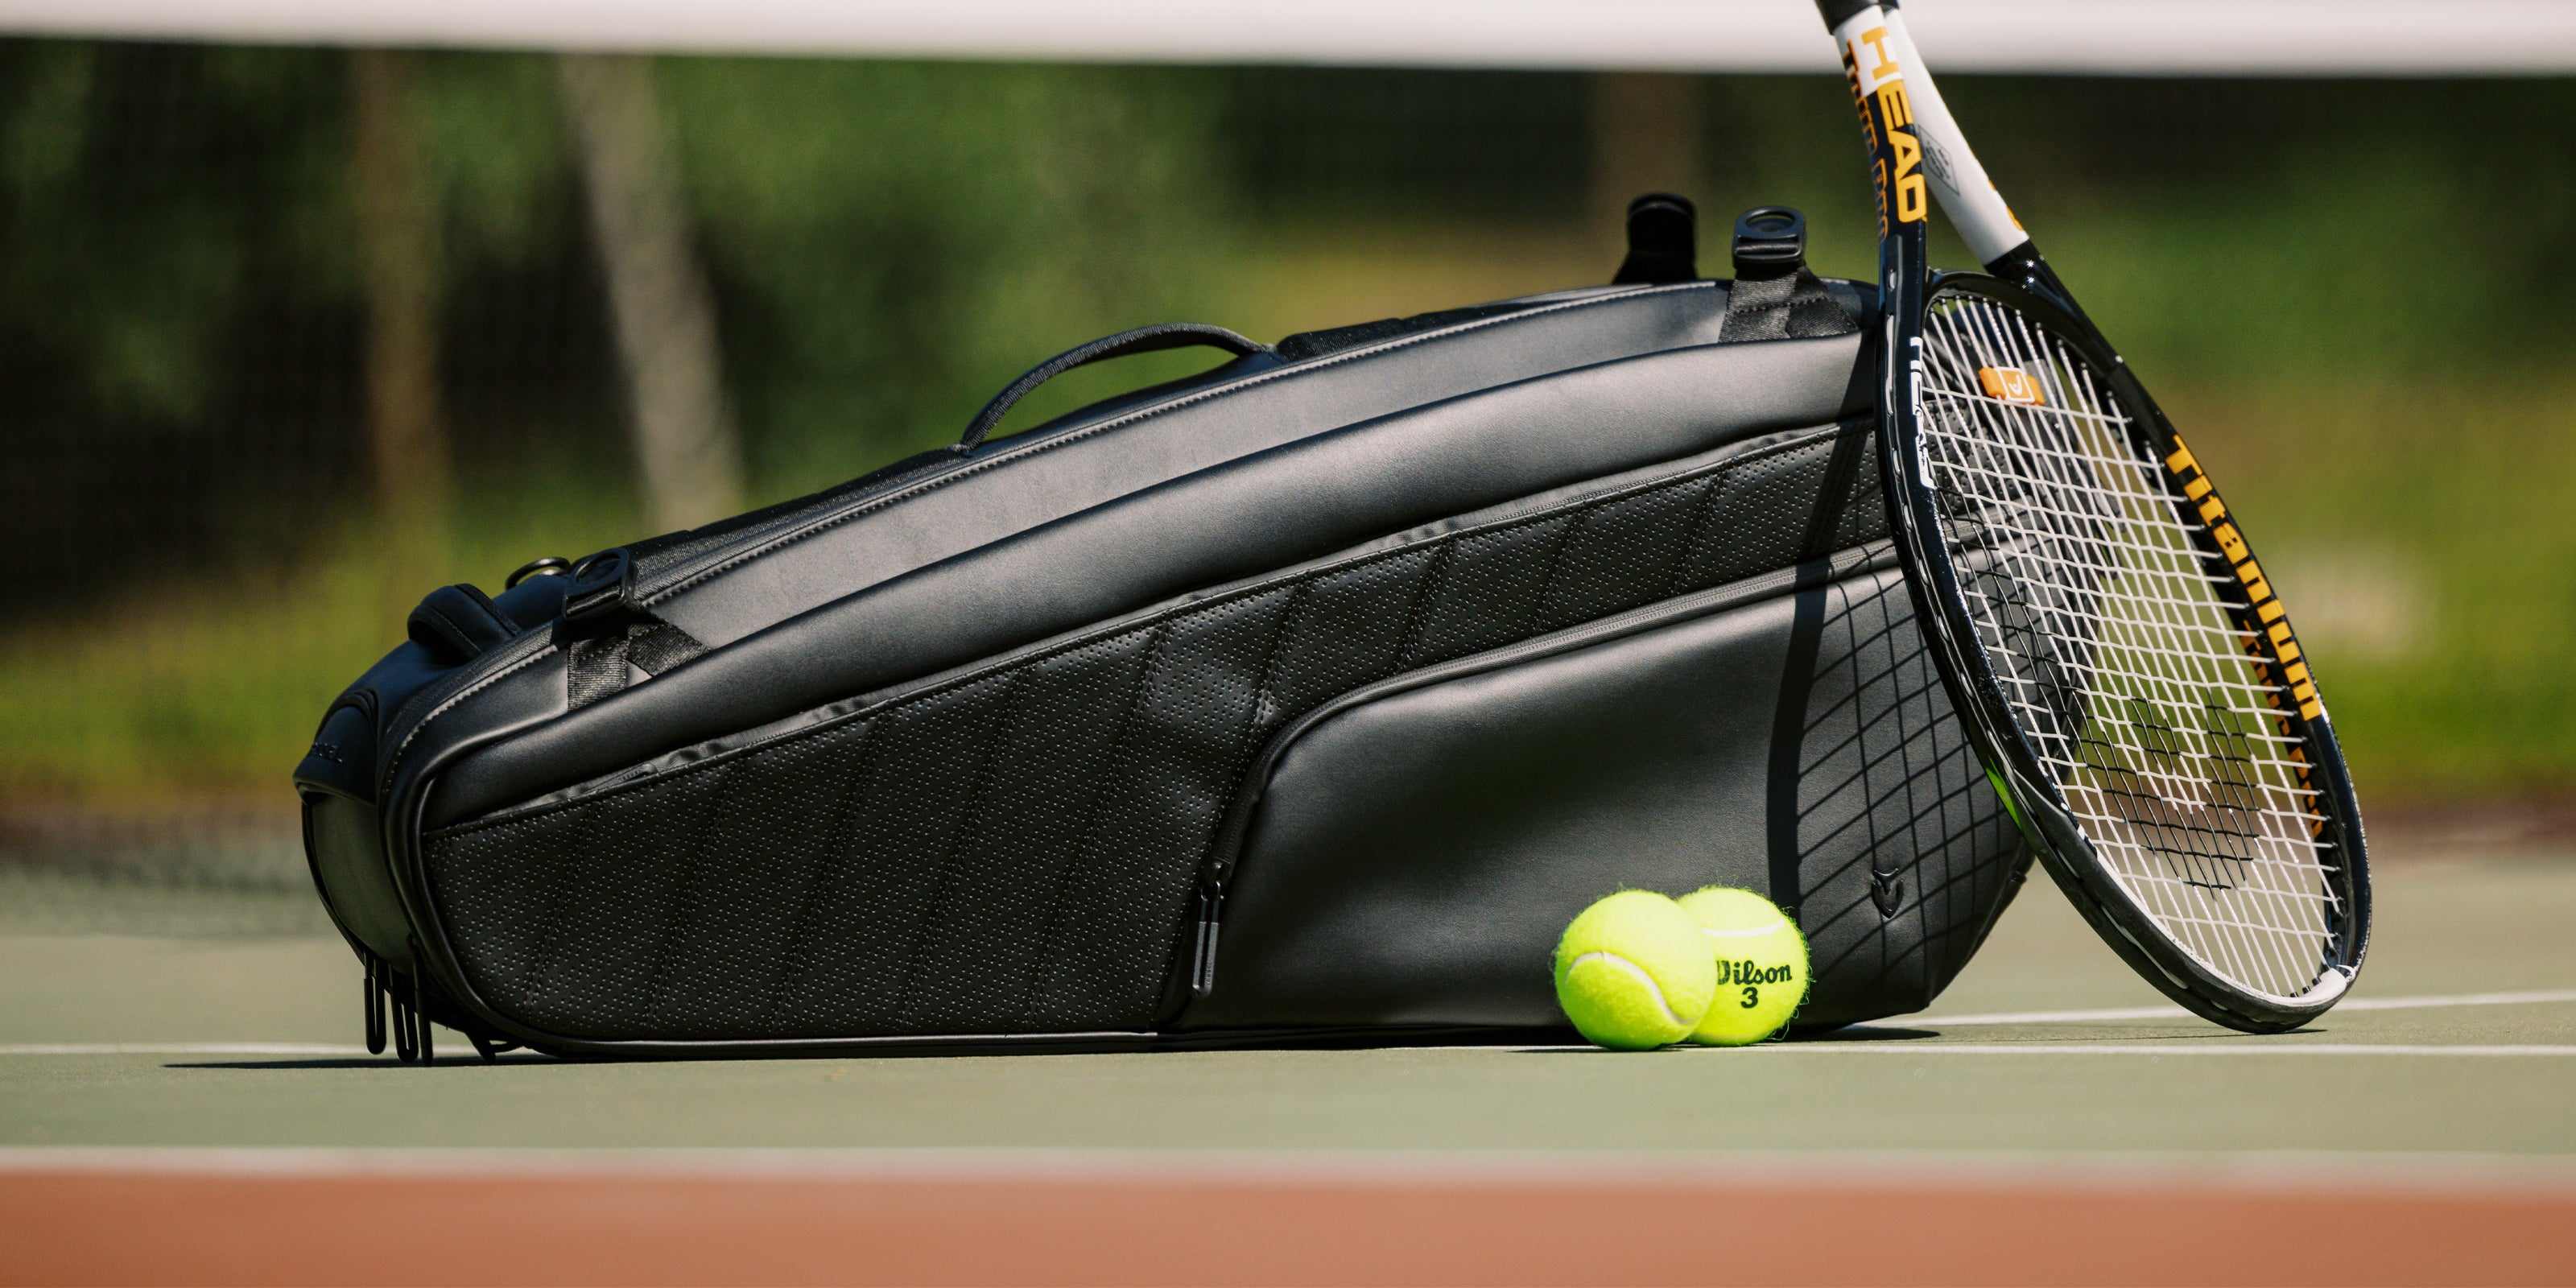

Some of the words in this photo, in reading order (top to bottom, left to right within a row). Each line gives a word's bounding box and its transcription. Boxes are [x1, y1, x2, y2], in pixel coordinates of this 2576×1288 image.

[1860, 26, 1927, 223] HEAD
[2165, 434, 2322, 721] Titanium
[1740, 987, 1758, 1009] 3
